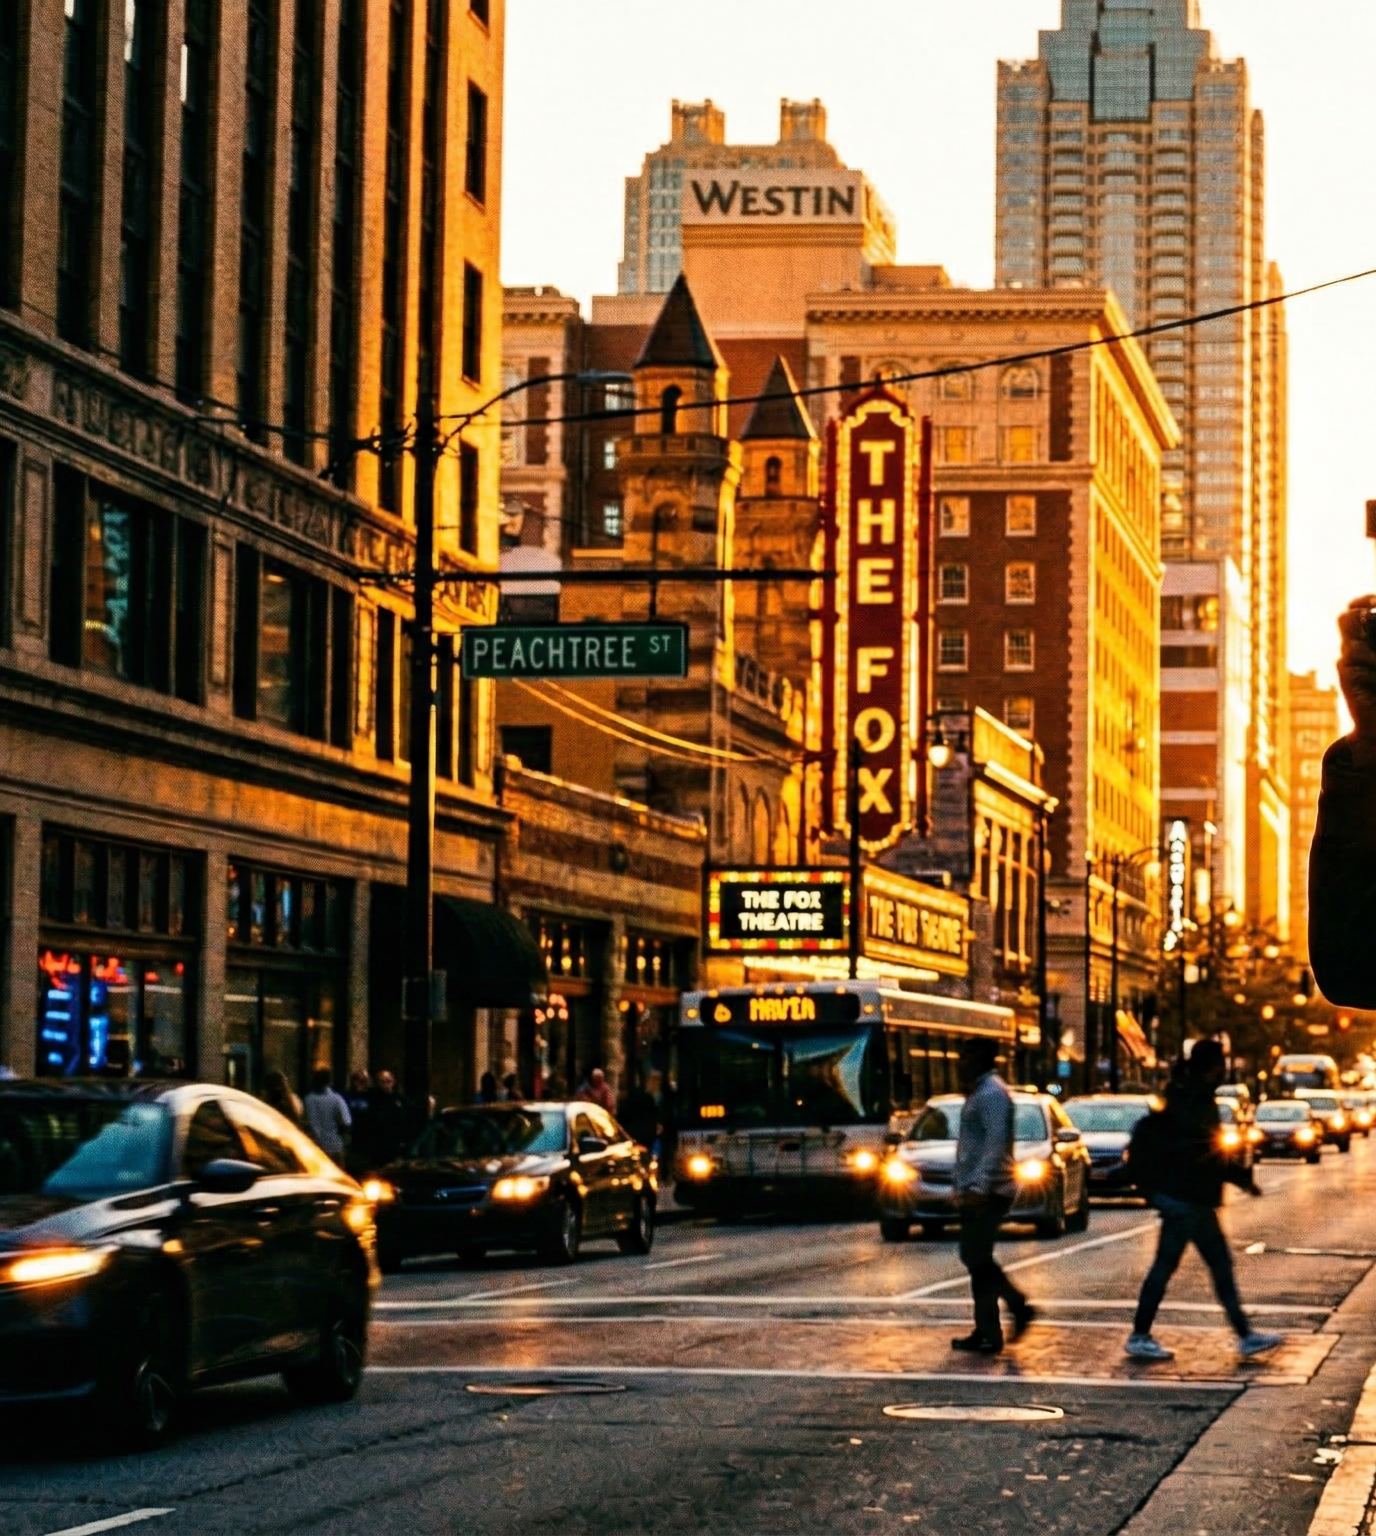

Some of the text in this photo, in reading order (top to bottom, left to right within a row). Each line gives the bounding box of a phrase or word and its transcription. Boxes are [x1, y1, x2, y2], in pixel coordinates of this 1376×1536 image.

[691, 180, 855, 216] WESTIN
[853, 440, 897, 813] THE FOX
[473, 634, 671, 670] PEACHTREE ST
[741, 890, 822, 909] THE FOX
[738, 912, 824, 931] THEATRE
